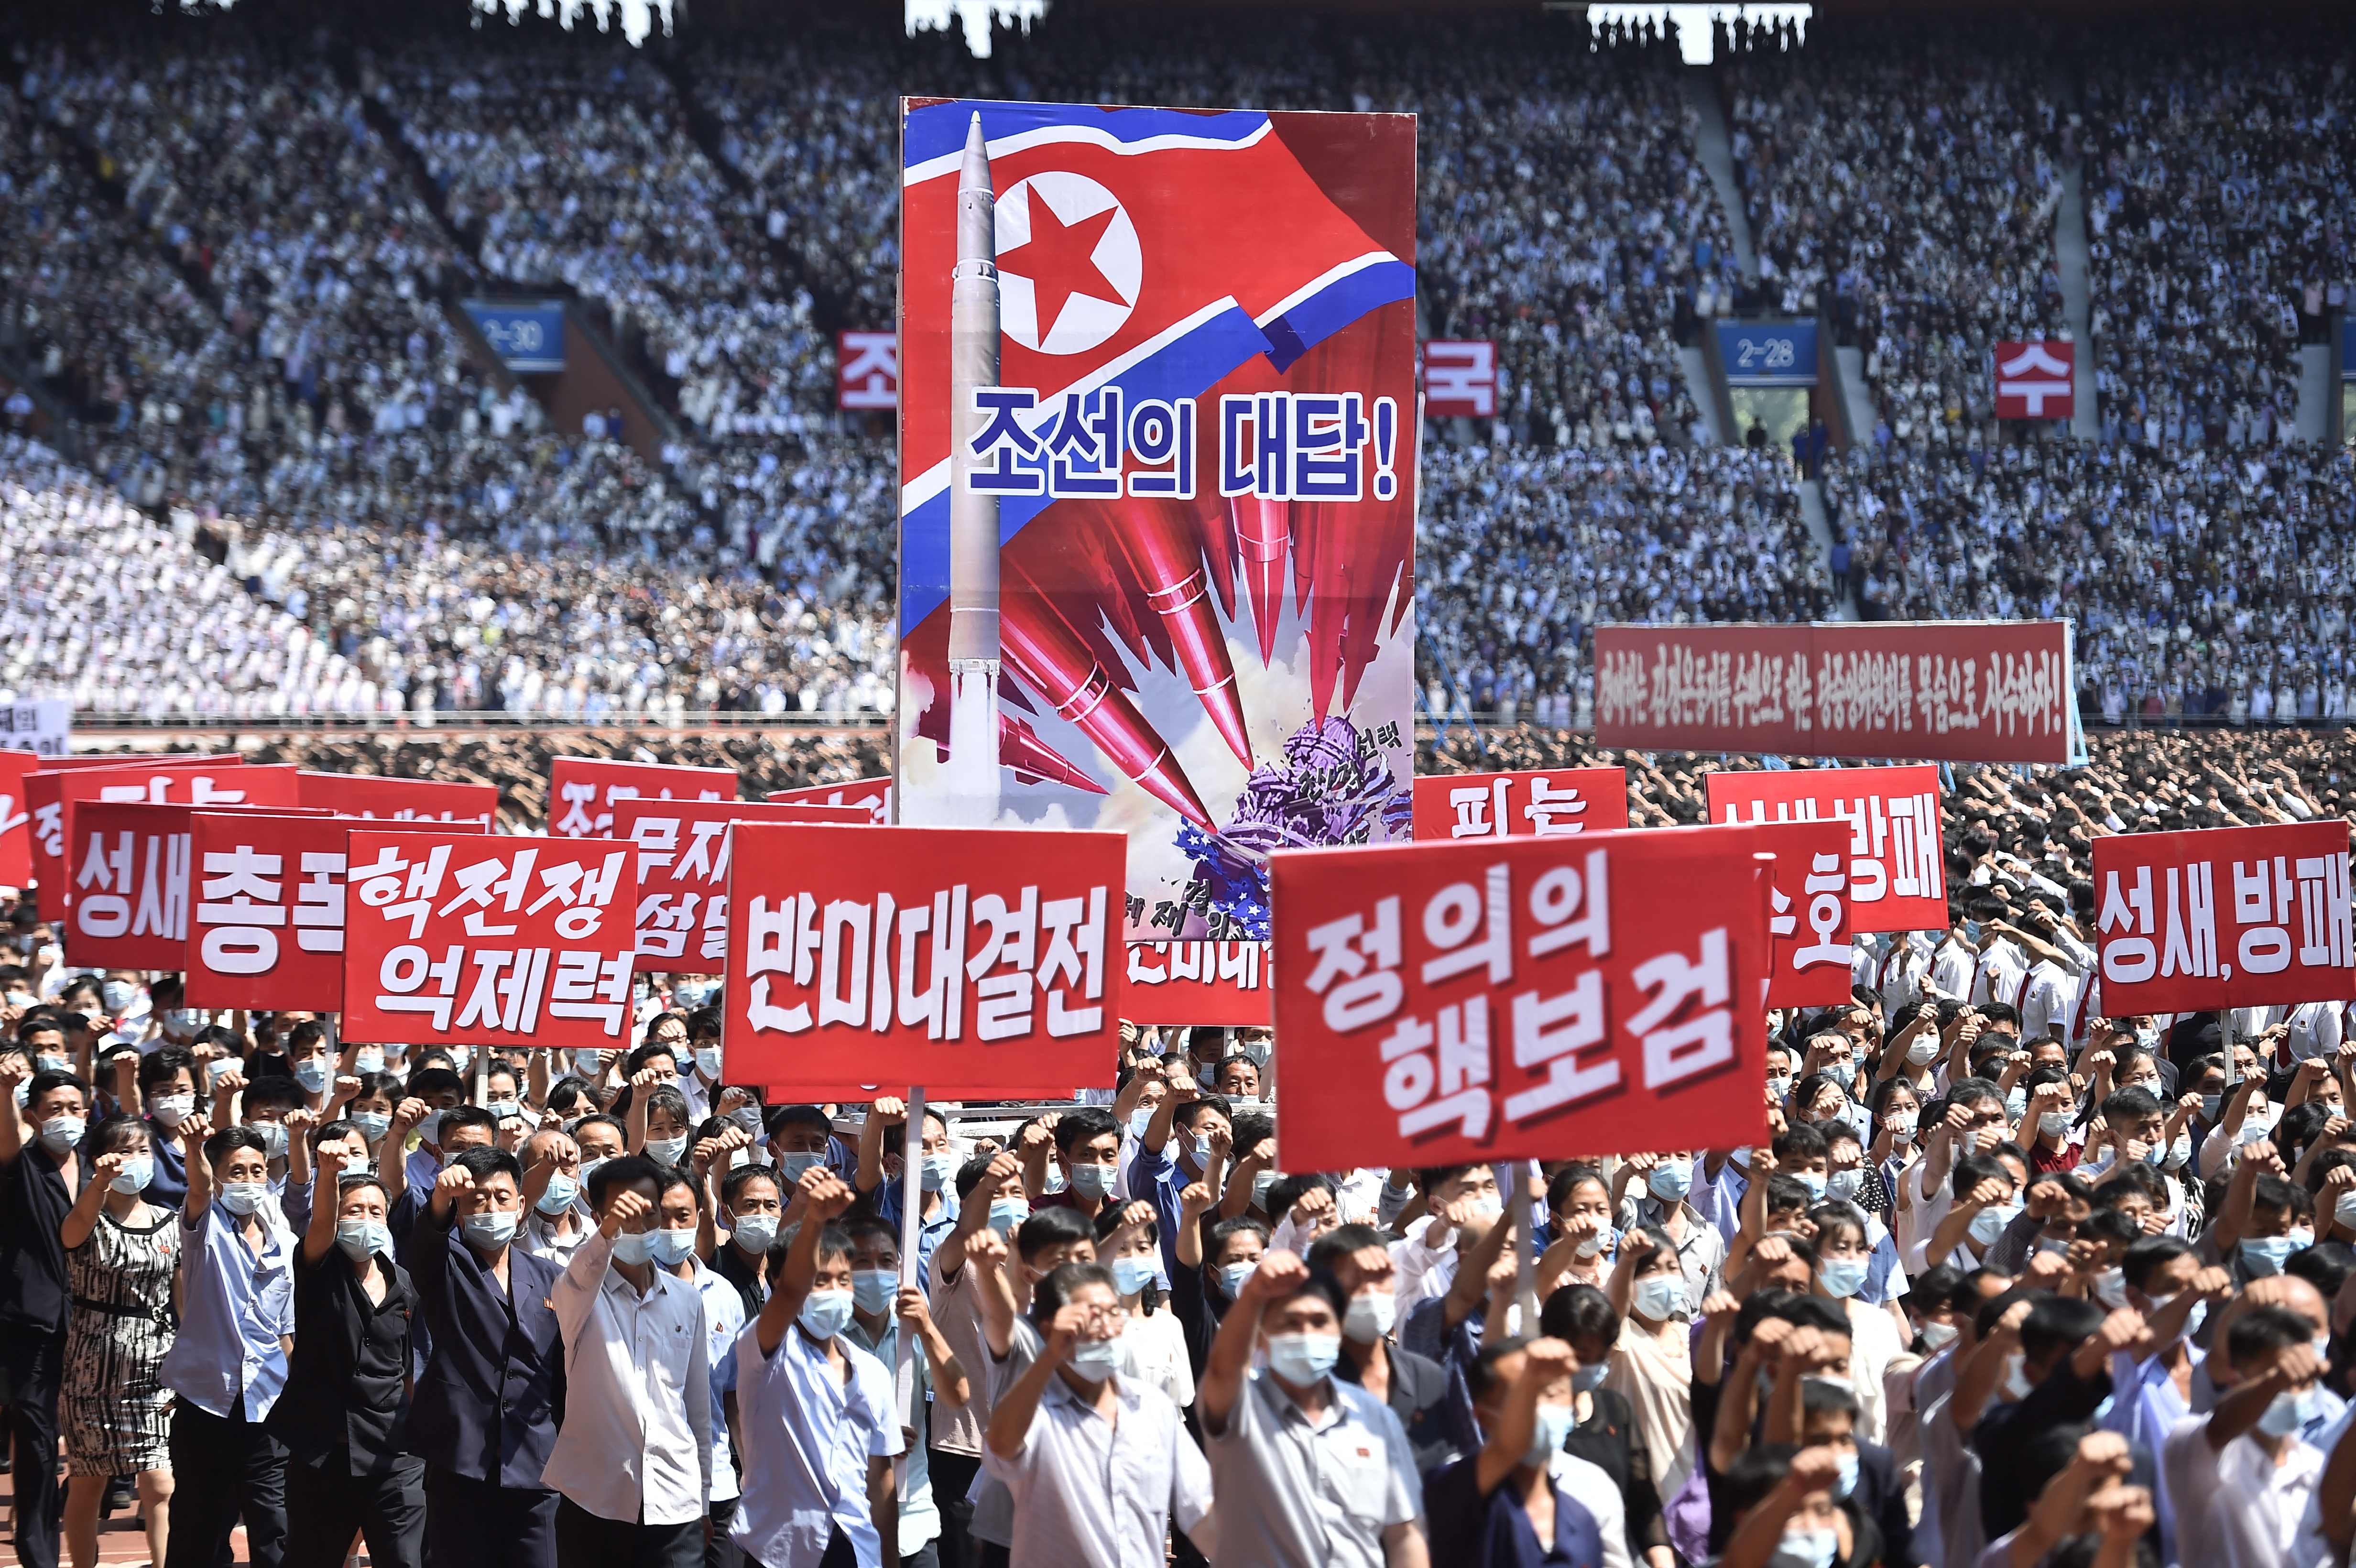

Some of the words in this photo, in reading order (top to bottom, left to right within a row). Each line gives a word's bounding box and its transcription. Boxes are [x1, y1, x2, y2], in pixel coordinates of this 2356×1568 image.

[841, 332, 896, 408] 조
[1426, 341, 1494, 415] 국
[1737, 338, 1795, 368] 2-28
[2000, 344, 2071, 416] 수
[966, 385, 1196, 500] 조선의
[1220, 391, 1397, 501] 대답!
[1785, 650, 1813, 733] 하는
[1917, 653, 1980, 735] 목숨으로
[1981, 648, 2062, 737] 사수하자!
[1450, 777, 1587, 838] 피는
[348, 844, 627, 940] 핵전쟁
[746, 884, 1107, 1041] 반미대결전
[1305, 848, 1610, 1032] 정의의
[375, 945, 635, 1036] 억제력
[1379, 926, 1733, 1140] 핵보검
